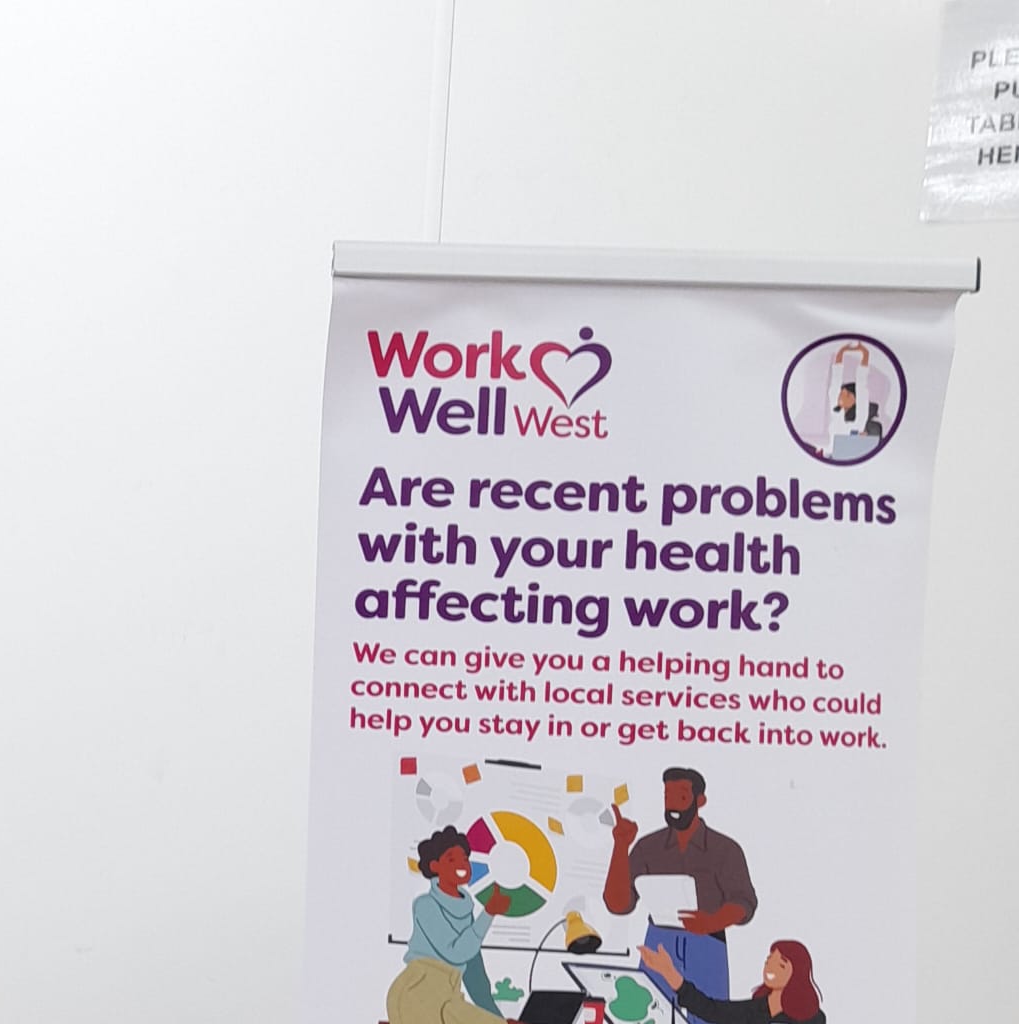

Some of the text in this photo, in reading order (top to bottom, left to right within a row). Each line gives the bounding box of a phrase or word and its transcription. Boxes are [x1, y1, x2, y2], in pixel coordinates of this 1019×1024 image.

[967, 112, 1019, 134] TAB
[367, 330, 526, 380] Work
[379, 386, 609, 439] Well West
[359, 467, 896, 526] Are recent problems
[358, 523, 800, 577] with your health
[355, 579, 790, 638] affecting work?
[353, 642, 844, 682] We can give you a helping hand to
[351, 679, 882, 715] connect with local services who could
[349, 708, 887, 748] help you stay in or get back into work.
